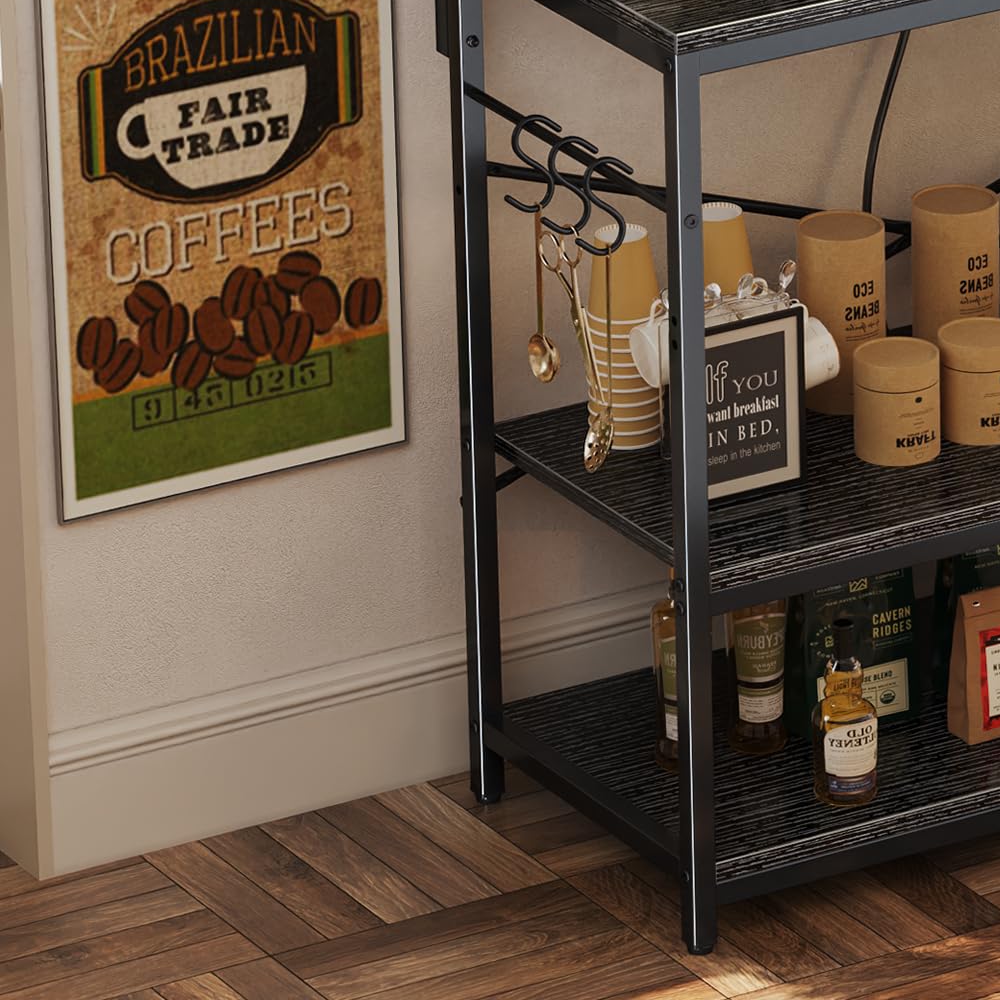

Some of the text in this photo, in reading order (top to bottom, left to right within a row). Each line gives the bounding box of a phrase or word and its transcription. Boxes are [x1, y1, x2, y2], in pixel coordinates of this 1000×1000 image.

[124, 8, 318, 95] BRAZILIAN
[177, 85, 273, 131] FAIR
[160, 114, 291, 165] TRADE
[104, 180, 355, 287] COFFEES
[704, 360, 779, 405] If YOU
[706, 394, 780, 425] want breakfast
[707, 418, 780, 449] IN BED,
[707, 441, 782, 467] sleep in the kitchen
[872, 605, 912, 626] CAVERN
[872, 619, 913, 639] RIDGES
